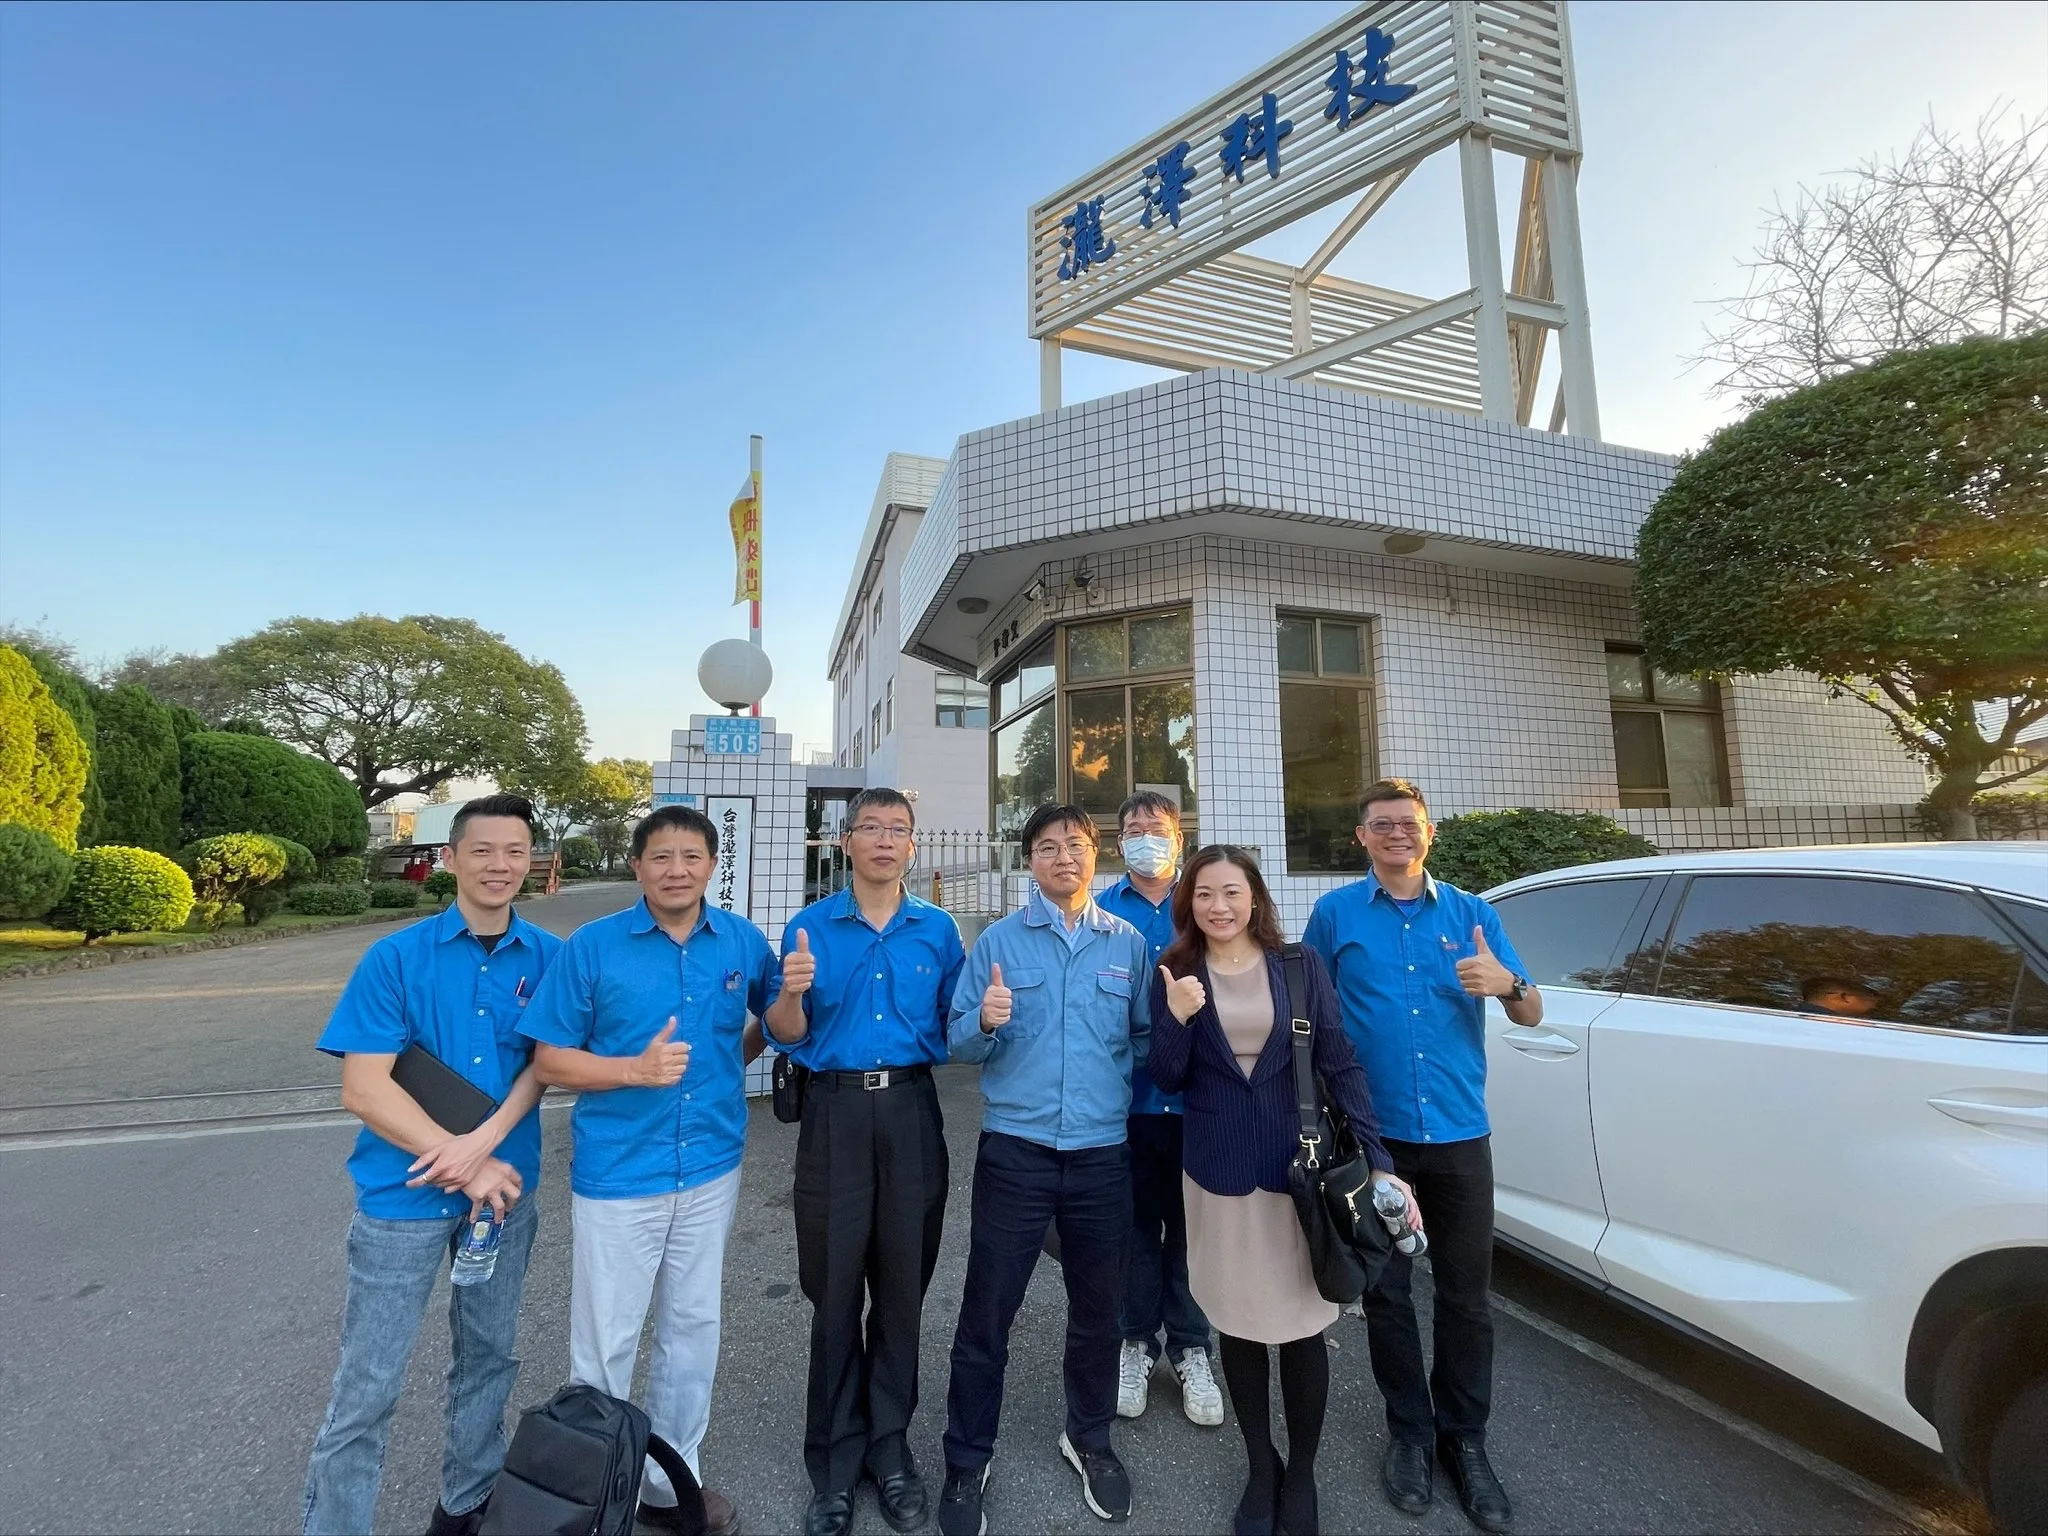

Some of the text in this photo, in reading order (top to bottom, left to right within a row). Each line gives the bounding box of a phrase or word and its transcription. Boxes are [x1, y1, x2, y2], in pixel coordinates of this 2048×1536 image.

[1057, 27, 1417, 281] 瀧澤科技
[718, 734, 758, 753] 505
